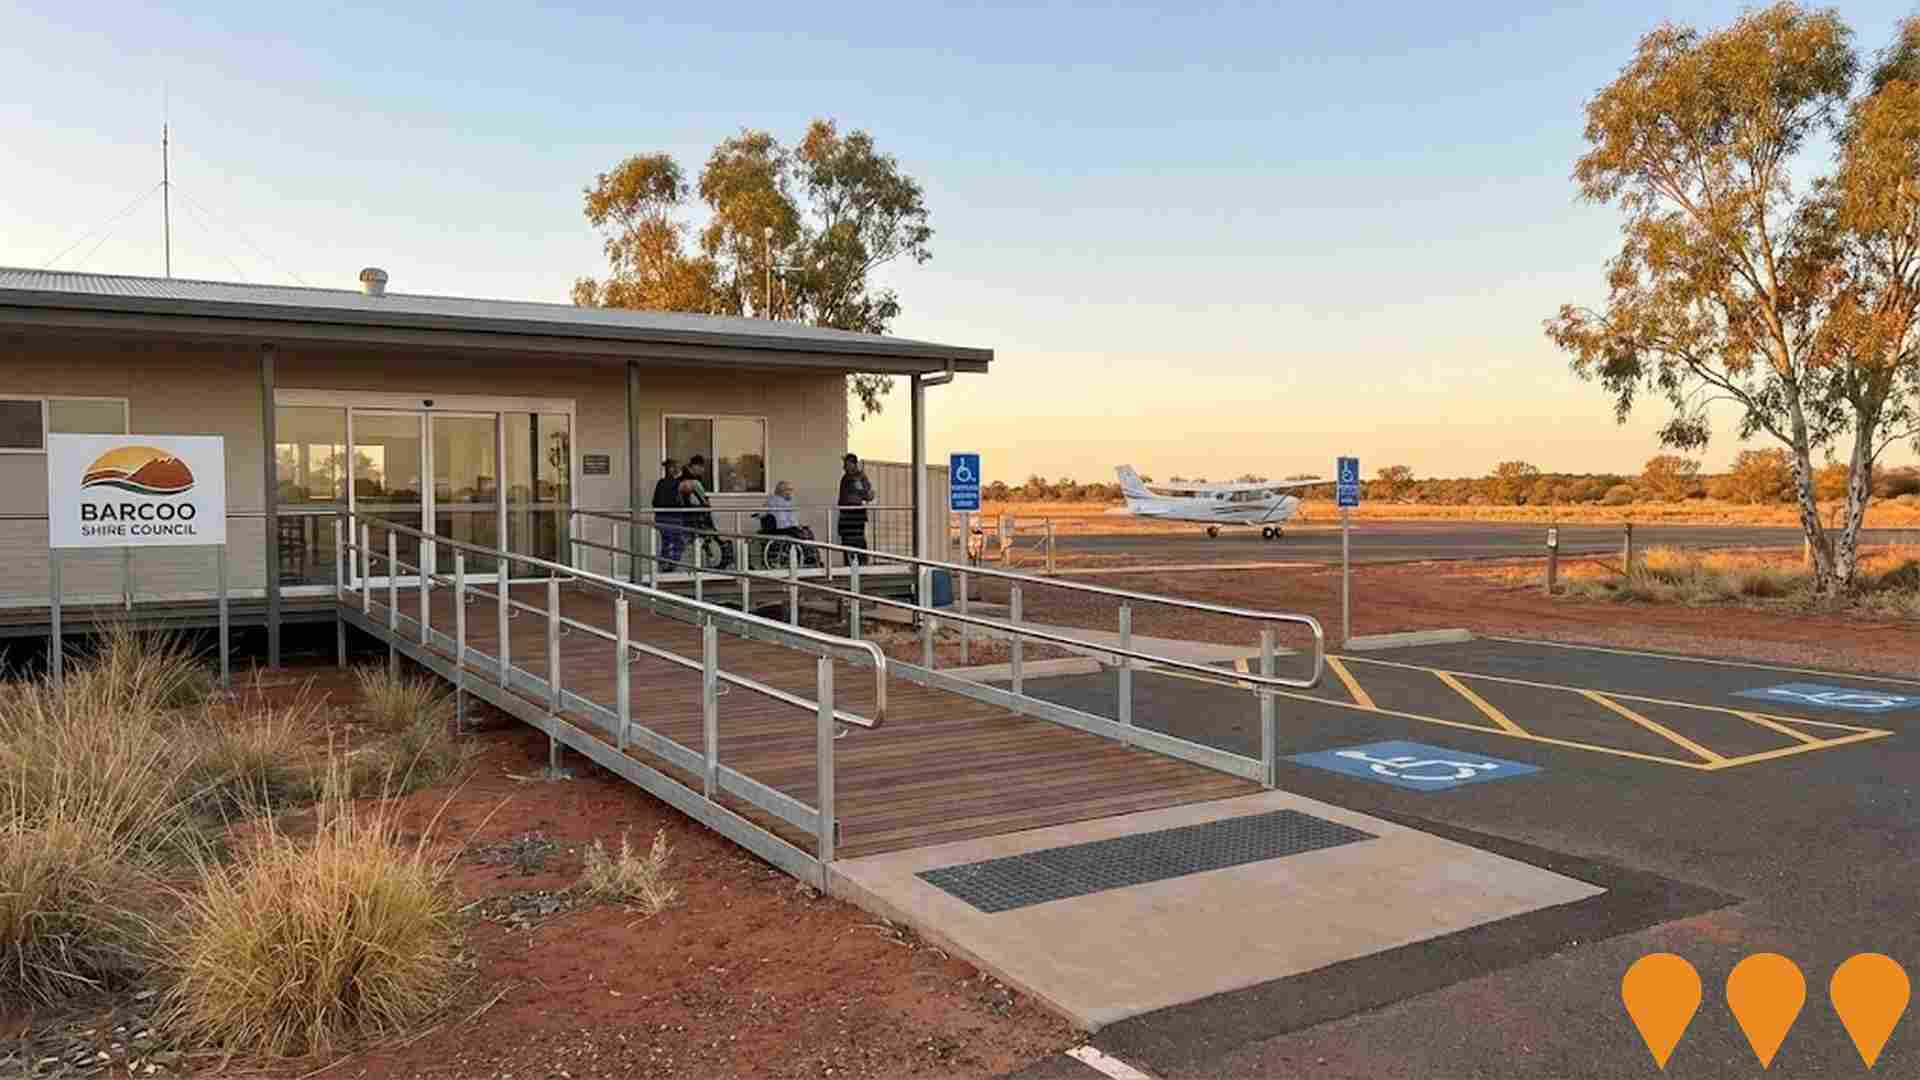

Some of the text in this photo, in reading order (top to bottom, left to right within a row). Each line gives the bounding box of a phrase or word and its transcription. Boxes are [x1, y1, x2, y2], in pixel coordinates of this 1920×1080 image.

[81, 503, 196, 521] BARCOO
[81, 524, 197, 536] SHIRE COUNCIL
